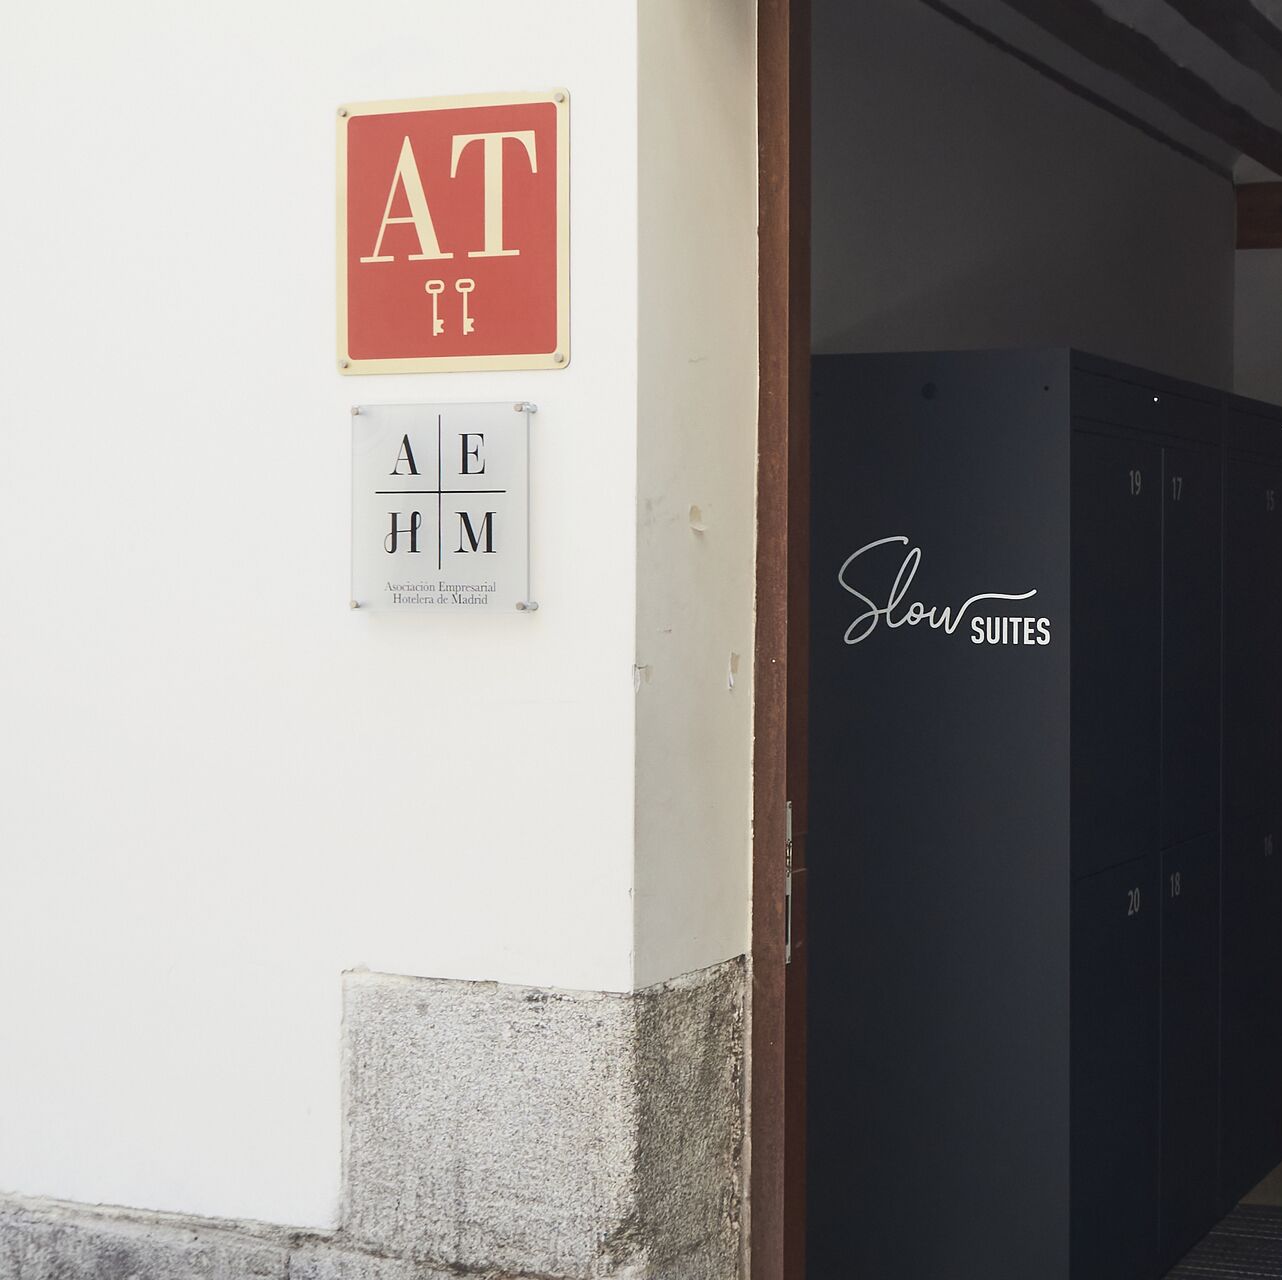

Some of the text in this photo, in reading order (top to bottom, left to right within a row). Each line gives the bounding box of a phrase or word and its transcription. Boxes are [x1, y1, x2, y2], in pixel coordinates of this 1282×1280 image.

[359, 129, 538, 264] AT
[388, 432, 487, 476] A E
[1128, 469, 1142, 496] 19
[1171, 476, 1183, 501] 17
[383, 510, 498, 554] H M
[392, 593, 489, 605] Hotelera de Madrid
[439, 581, 497, 594] Empresarial
[837, 534, 1052, 646] Slow SUITES
[1169, 871, 1181, 898] 18
[1127, 887, 1140, 916] 20
